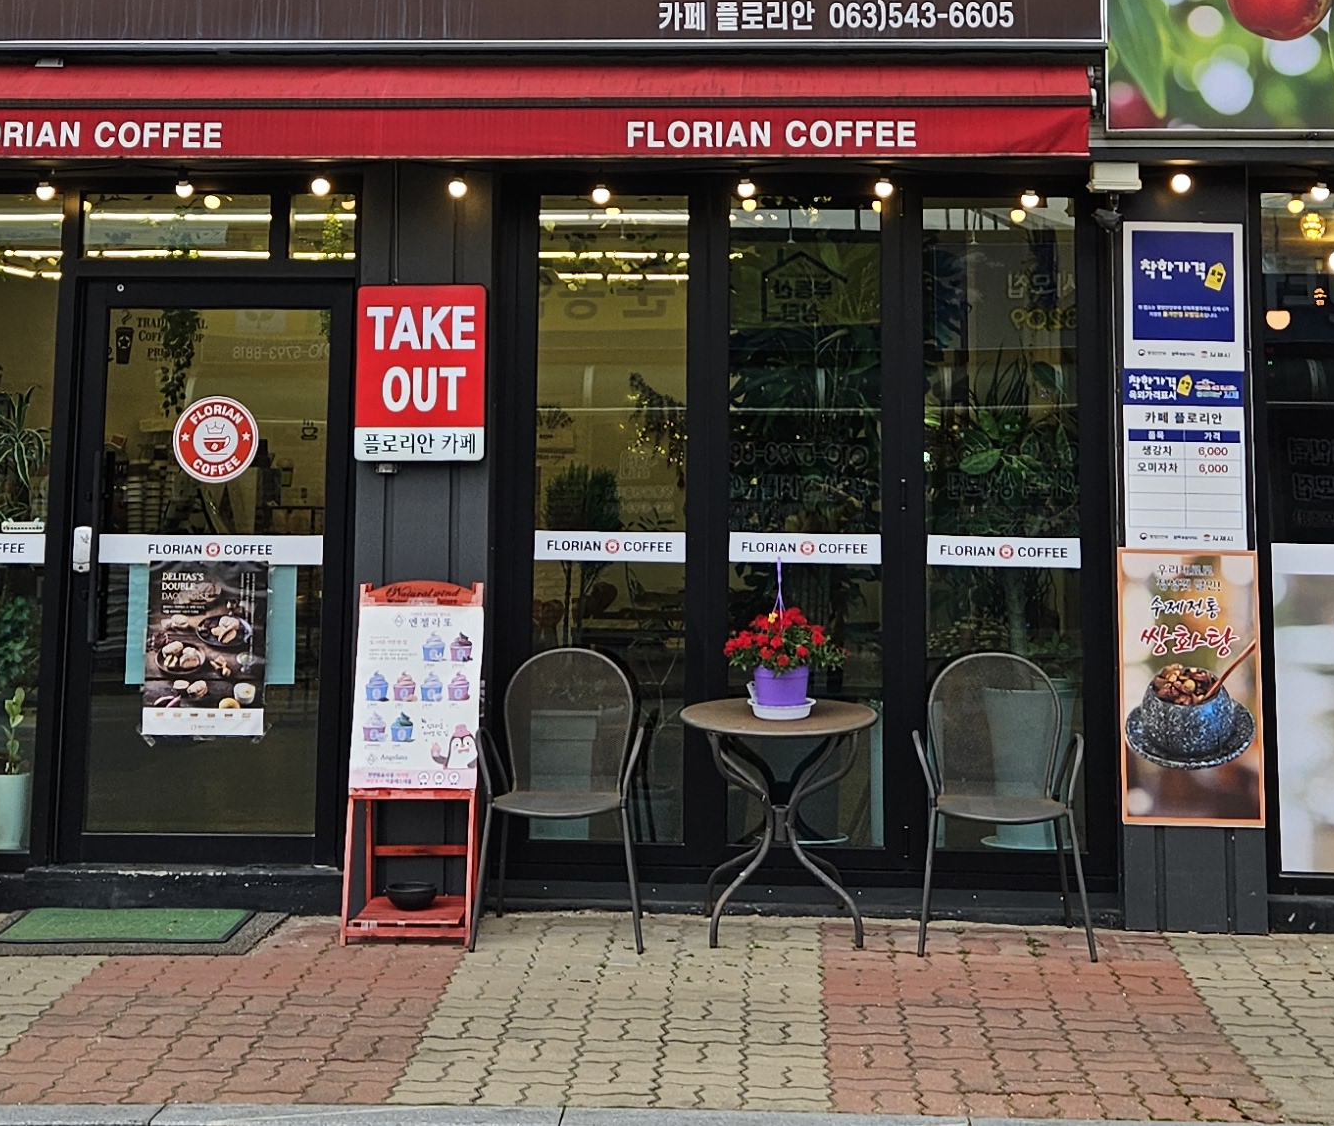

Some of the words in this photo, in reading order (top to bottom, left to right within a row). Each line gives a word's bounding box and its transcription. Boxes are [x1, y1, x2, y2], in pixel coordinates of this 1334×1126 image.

[658, 1, 706, 31] 카페
[715, 0, 816, 31] 플로리안
[829, 0, 1014, 32] 063)543-6605
[94, 121, 223, 149] COFFEE
[627, 120, 771, 148] FLORIAN
[785, 120, 917, 148] COFFEE
[1140, 258, 1206, 281] 착한가격
[137, 317, 208, 330] TRADAL
[366, 305, 476, 351] TAKE
[382, 366, 467, 413] OUT
[189, 404, 244, 425] FLORIAN
[1145, 412, 1169, 424] 카페
[1175, 412, 1222, 425] 플로리안
[364, 433, 435, 454] 플로리안
[442, 433, 475, 454] 카페
[1204, 432, 1221, 441] 가격
[1142, 445, 1172, 456] 생강차
[1198, 447, 1228, 458] 6,000
[193, 456, 241, 475] COFFEE
[1137, 462, 1178, 473] 오미자차
[1199, 464, 1228, 475] 6,000
[148, 543, 202, 555] FLORIAN
[224, 544, 273, 556] COFFEE
[546, 540, 602, 552] FLORIAN
[623, 541, 673, 553] COFFEE
[741, 541, 797, 553] FLORIAN
[818, 543, 868, 555] COFFEE
[939, 545, 996, 557] FLORIAN
[1017, 546, 1069, 558] COFFEE
[162, 582, 197, 591] DOUBLE
[1150, 596, 1221, 619] 수제전통
[1140, 625, 1240, 656] 쌍화탕
